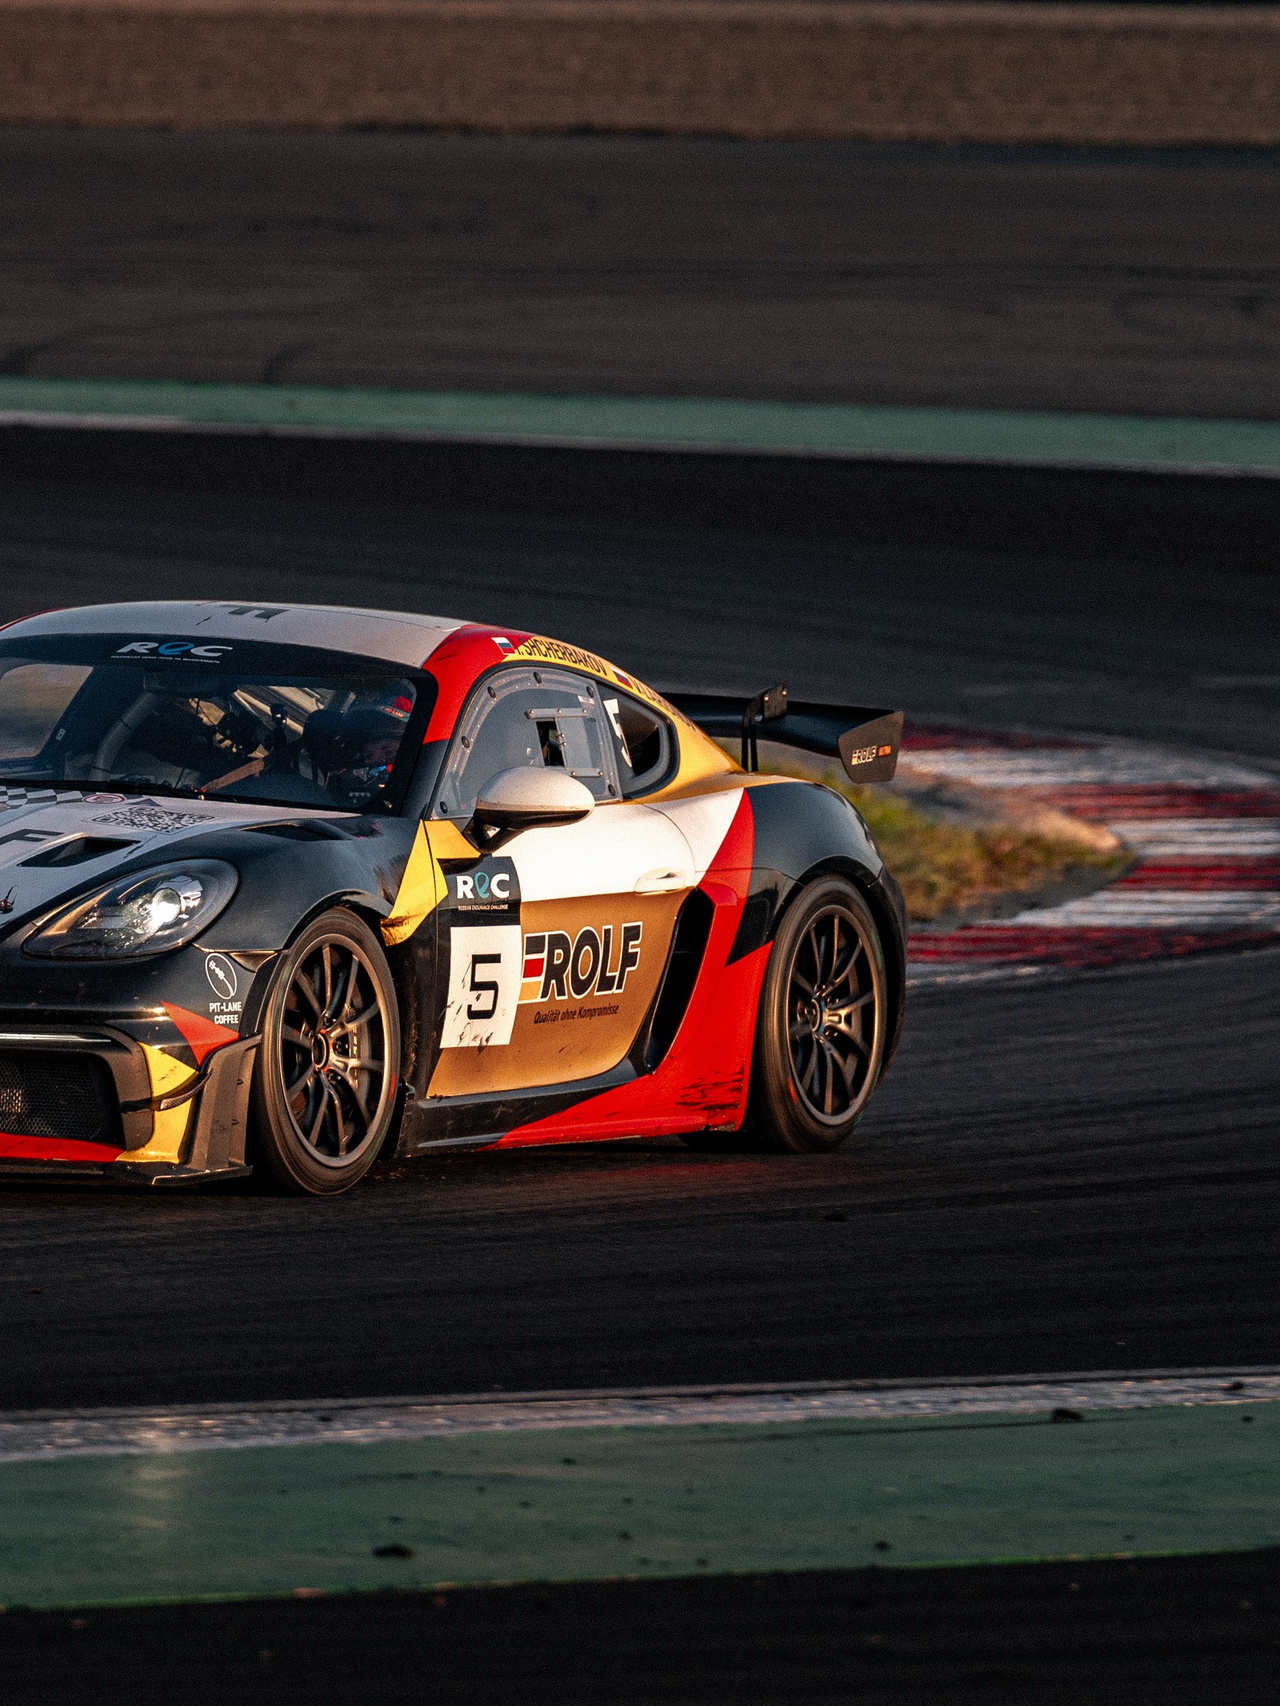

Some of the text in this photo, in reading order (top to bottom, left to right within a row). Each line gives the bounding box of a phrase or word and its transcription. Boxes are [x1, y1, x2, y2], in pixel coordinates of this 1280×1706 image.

[602, 698, 632, 768] 5
[540, 921, 643, 1000] ROLF
[209, 1001, 242, 1013] PIT-LANE
[467, 953, 502, 1020] 5
[214, 1014, 239, 1025] COFFEE
[533, 1003, 620, 1025] Qualität ohne Kompromisse
